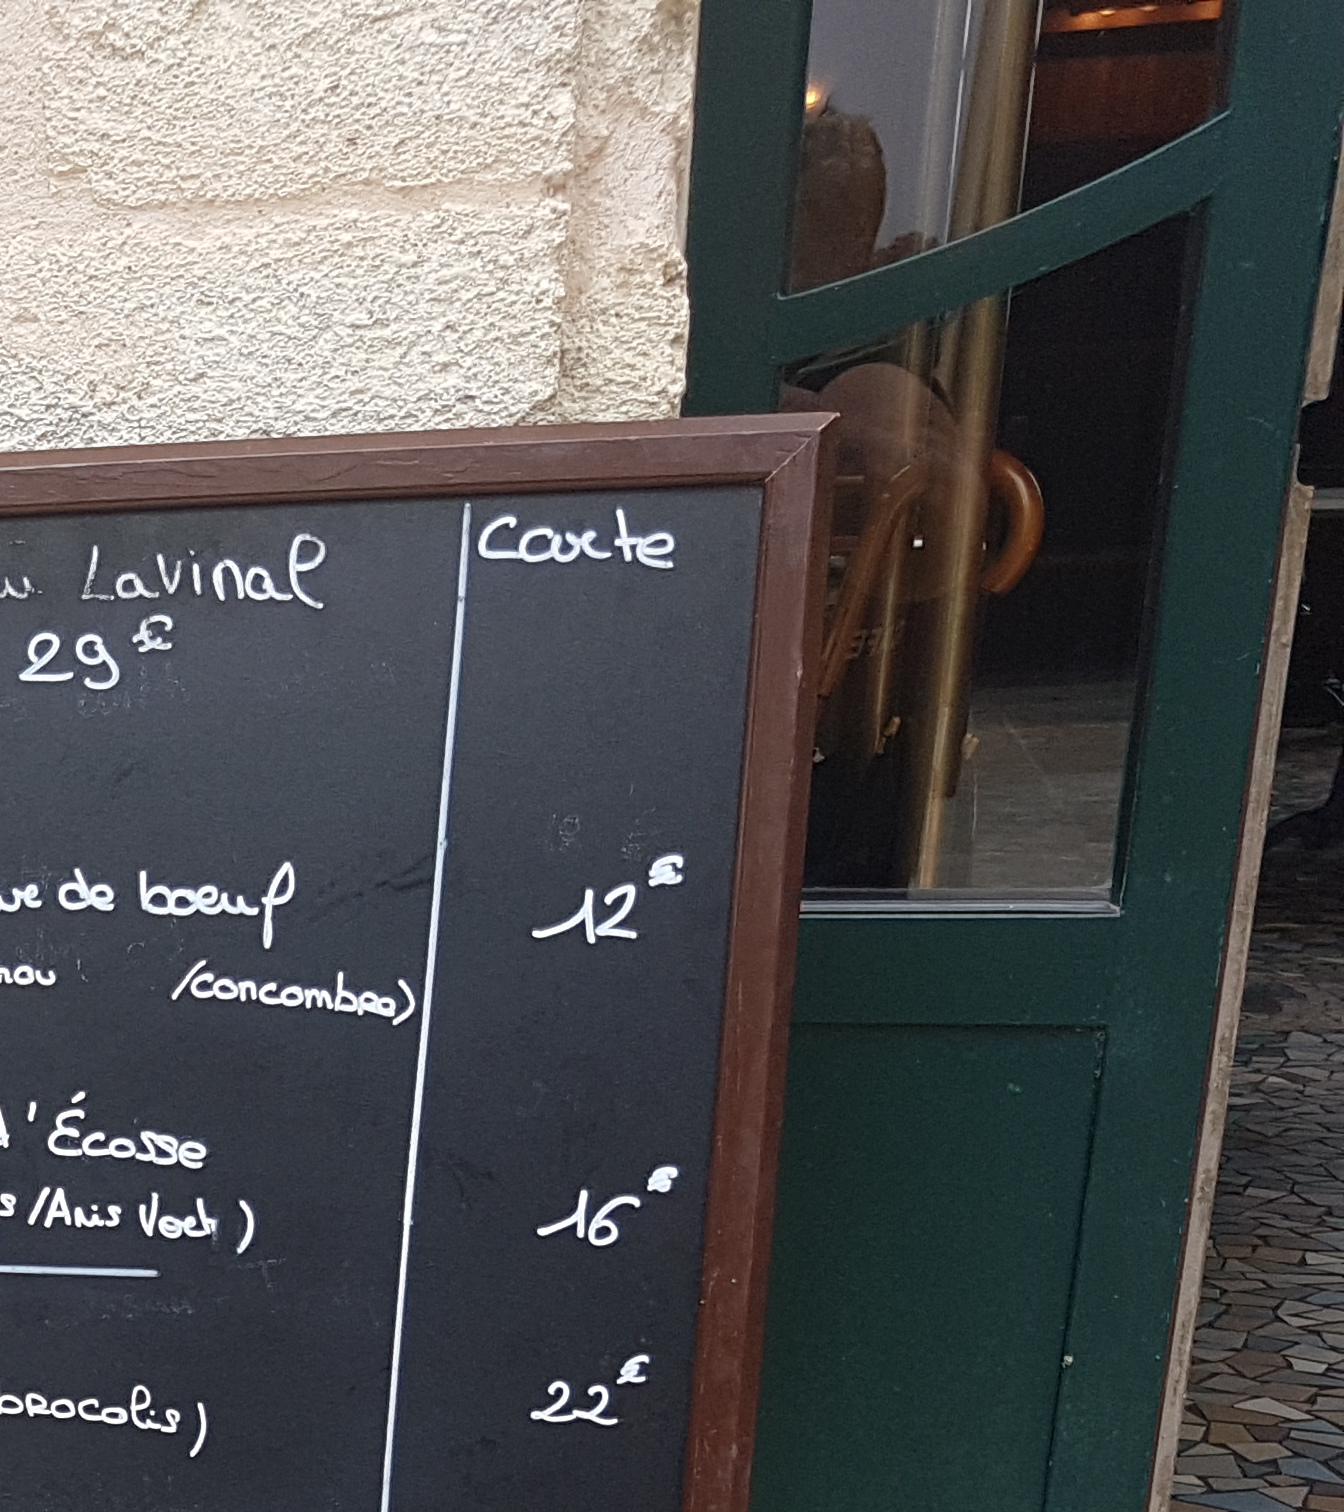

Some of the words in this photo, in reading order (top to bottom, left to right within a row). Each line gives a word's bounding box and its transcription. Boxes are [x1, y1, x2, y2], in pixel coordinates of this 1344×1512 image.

[80, 531, 327, 610] Lavinal
[477, 505, 676, 570] Carte
[57, 867, 116, 912] de
[531, 852, 685, 945] 12€
[536, 1165, 680, 1247] 16€
[529, 1354, 651, 1426] 22€
